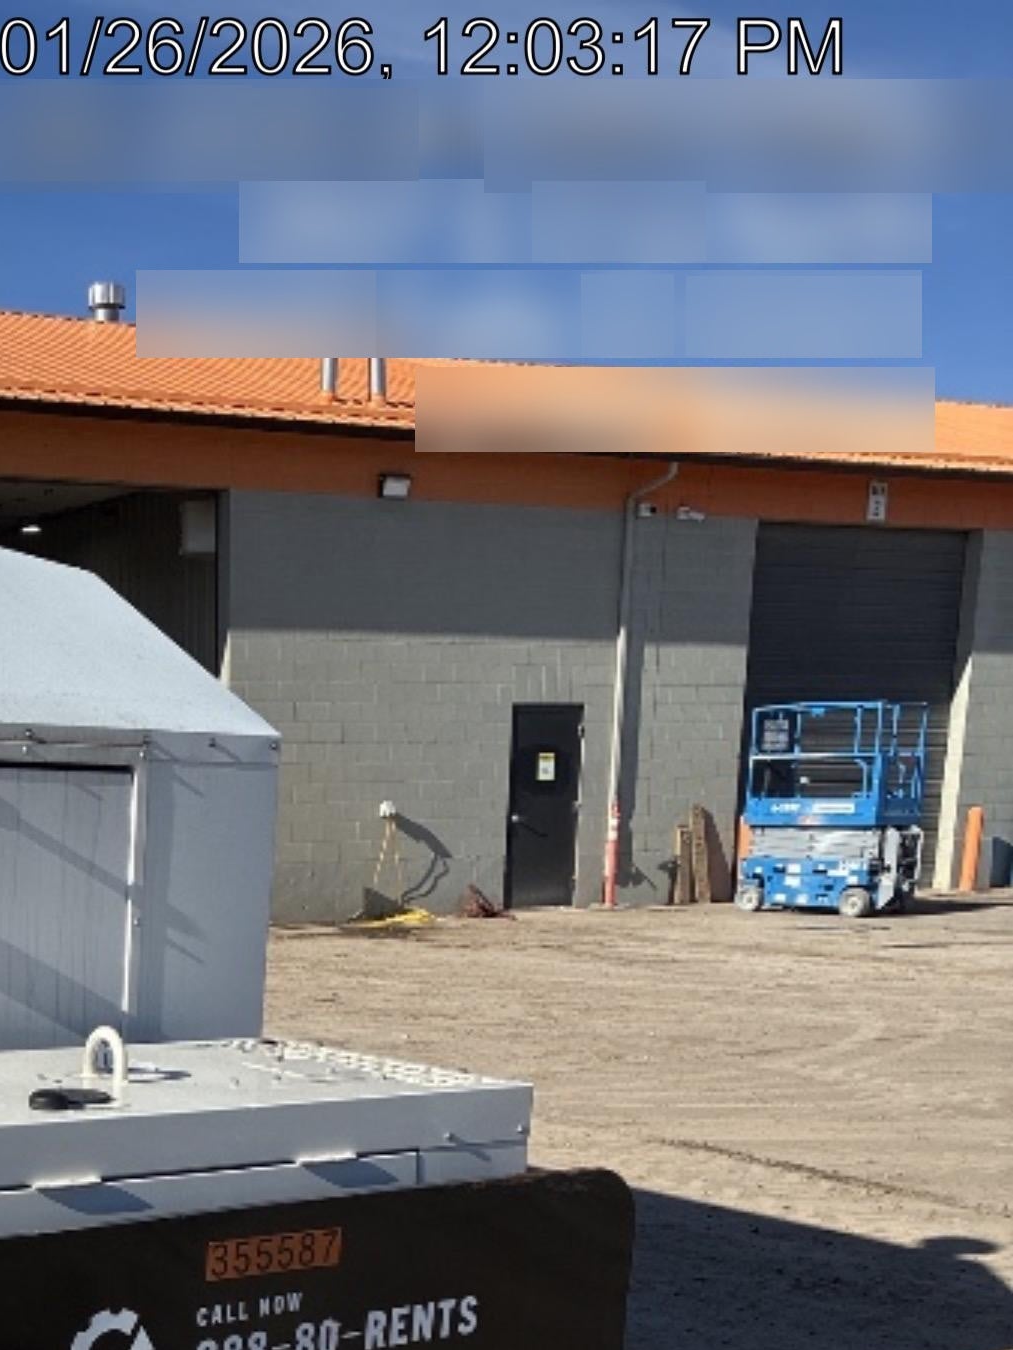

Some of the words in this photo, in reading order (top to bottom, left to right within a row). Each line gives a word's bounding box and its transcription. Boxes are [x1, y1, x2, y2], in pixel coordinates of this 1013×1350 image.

[210, 1230, 340, 1279] 355587
[196, 1302, 249, 1327] CALL
[259, 1291, 304, 1318] NOW
